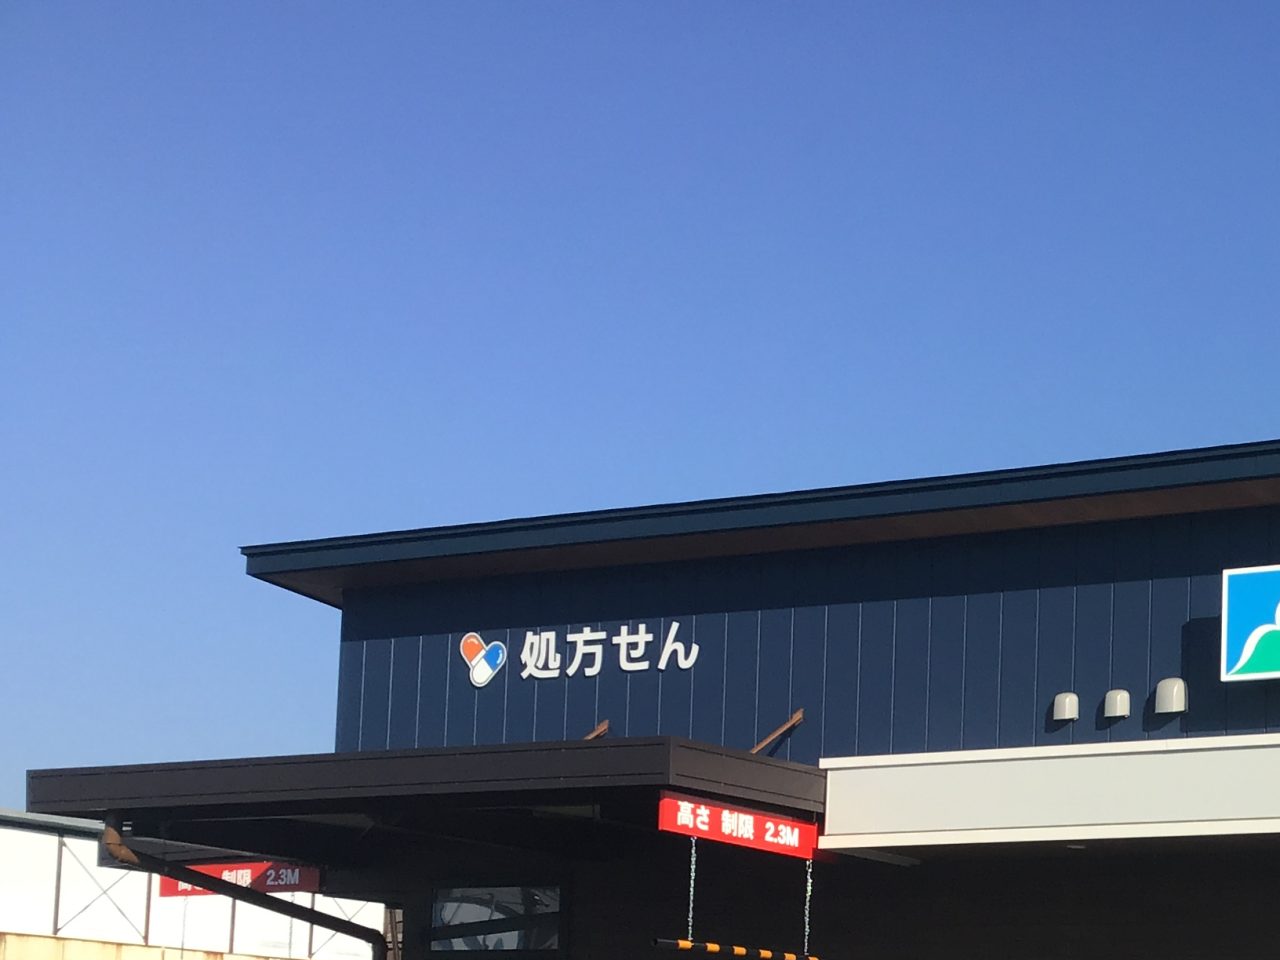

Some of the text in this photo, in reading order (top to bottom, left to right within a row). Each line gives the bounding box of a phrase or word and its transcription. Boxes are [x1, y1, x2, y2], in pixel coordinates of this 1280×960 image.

[519, 621, 700, 680] 処方せん
[677, 801, 800, 848] 高さ 制限 2.3M
[265, 868, 300, 886] 2.3M
